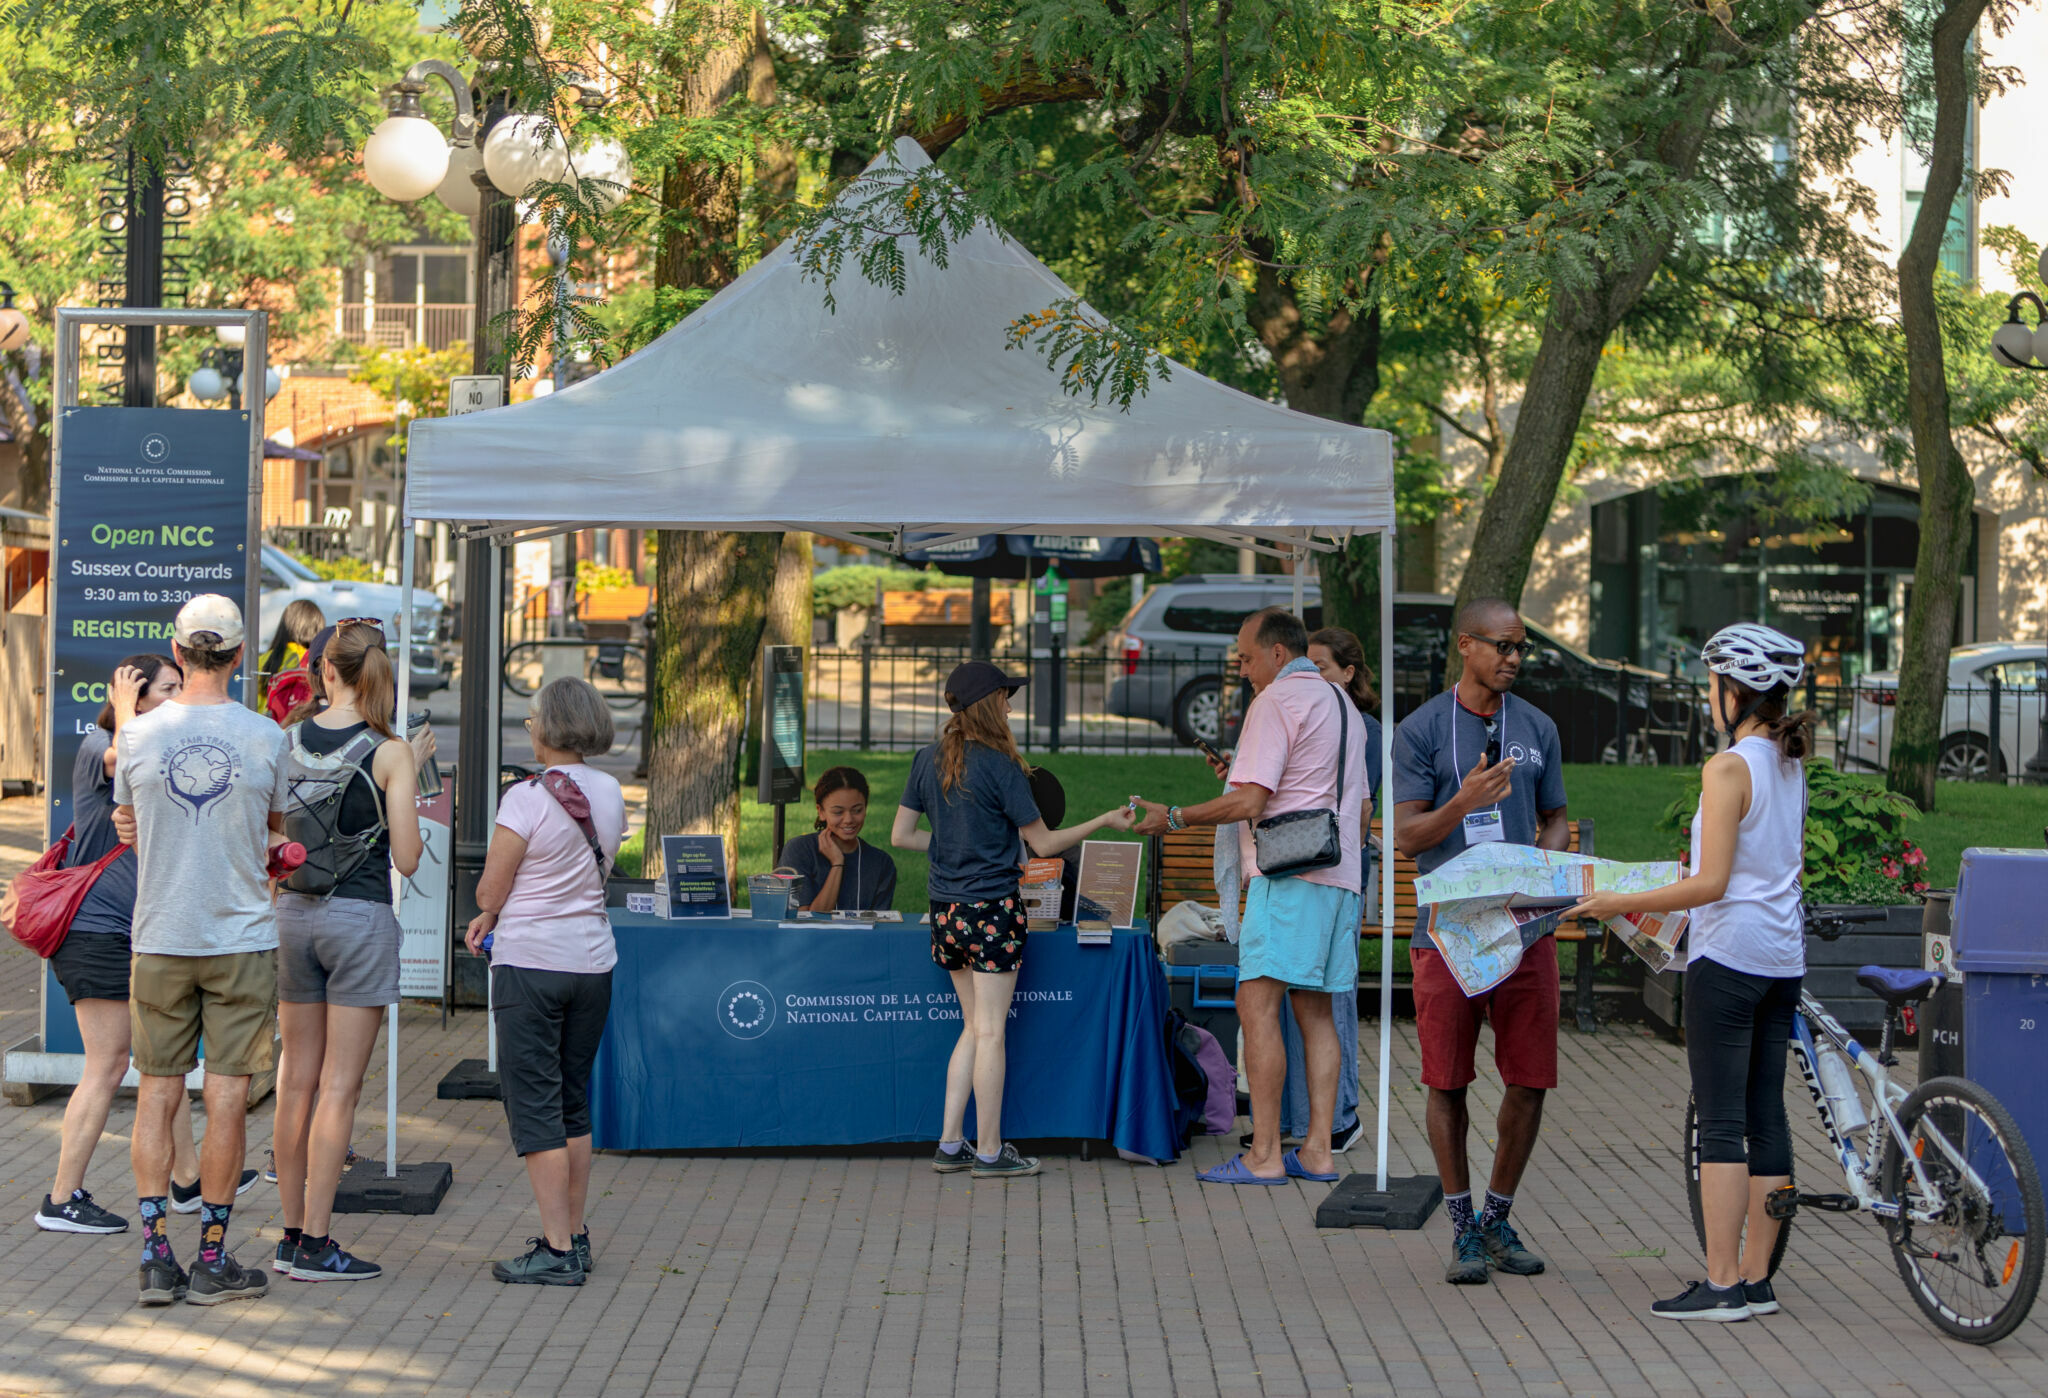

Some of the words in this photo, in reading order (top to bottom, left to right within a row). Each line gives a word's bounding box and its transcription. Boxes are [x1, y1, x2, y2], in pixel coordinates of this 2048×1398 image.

[469, 391, 483, 405] NO
[98, 466, 133, 474] NATIONAL
[135, 467, 164, 475] CAPITAL
[167, 468, 212, 476] COMMISSION
[91, 523, 155, 549] Open
[161, 525, 214, 547] NCC
[71, 559, 131, 577] Sussex
[134, 561, 233, 582] Courtyards
[84, 588, 116, 601] 9:30
[118, 591, 140, 602] am
[143, 590, 158, 602] to
[160, 590, 191, 603] 3:30
[403, 928, 438, 936] IFFURE
[785, 994, 875, 1007] COMMISSION
[881, 994, 899, 1005] DE
[904, 994, 921, 1004] LA
[786, 1010, 858, 1024] NATIONAL
[863, 1008, 923, 1022] CAPITAL
[2019, 1018, 2036, 1031] 20
[1932, 1028, 1959, 1046] PCH
[1793, 1047, 1843, 1150] GIANT
